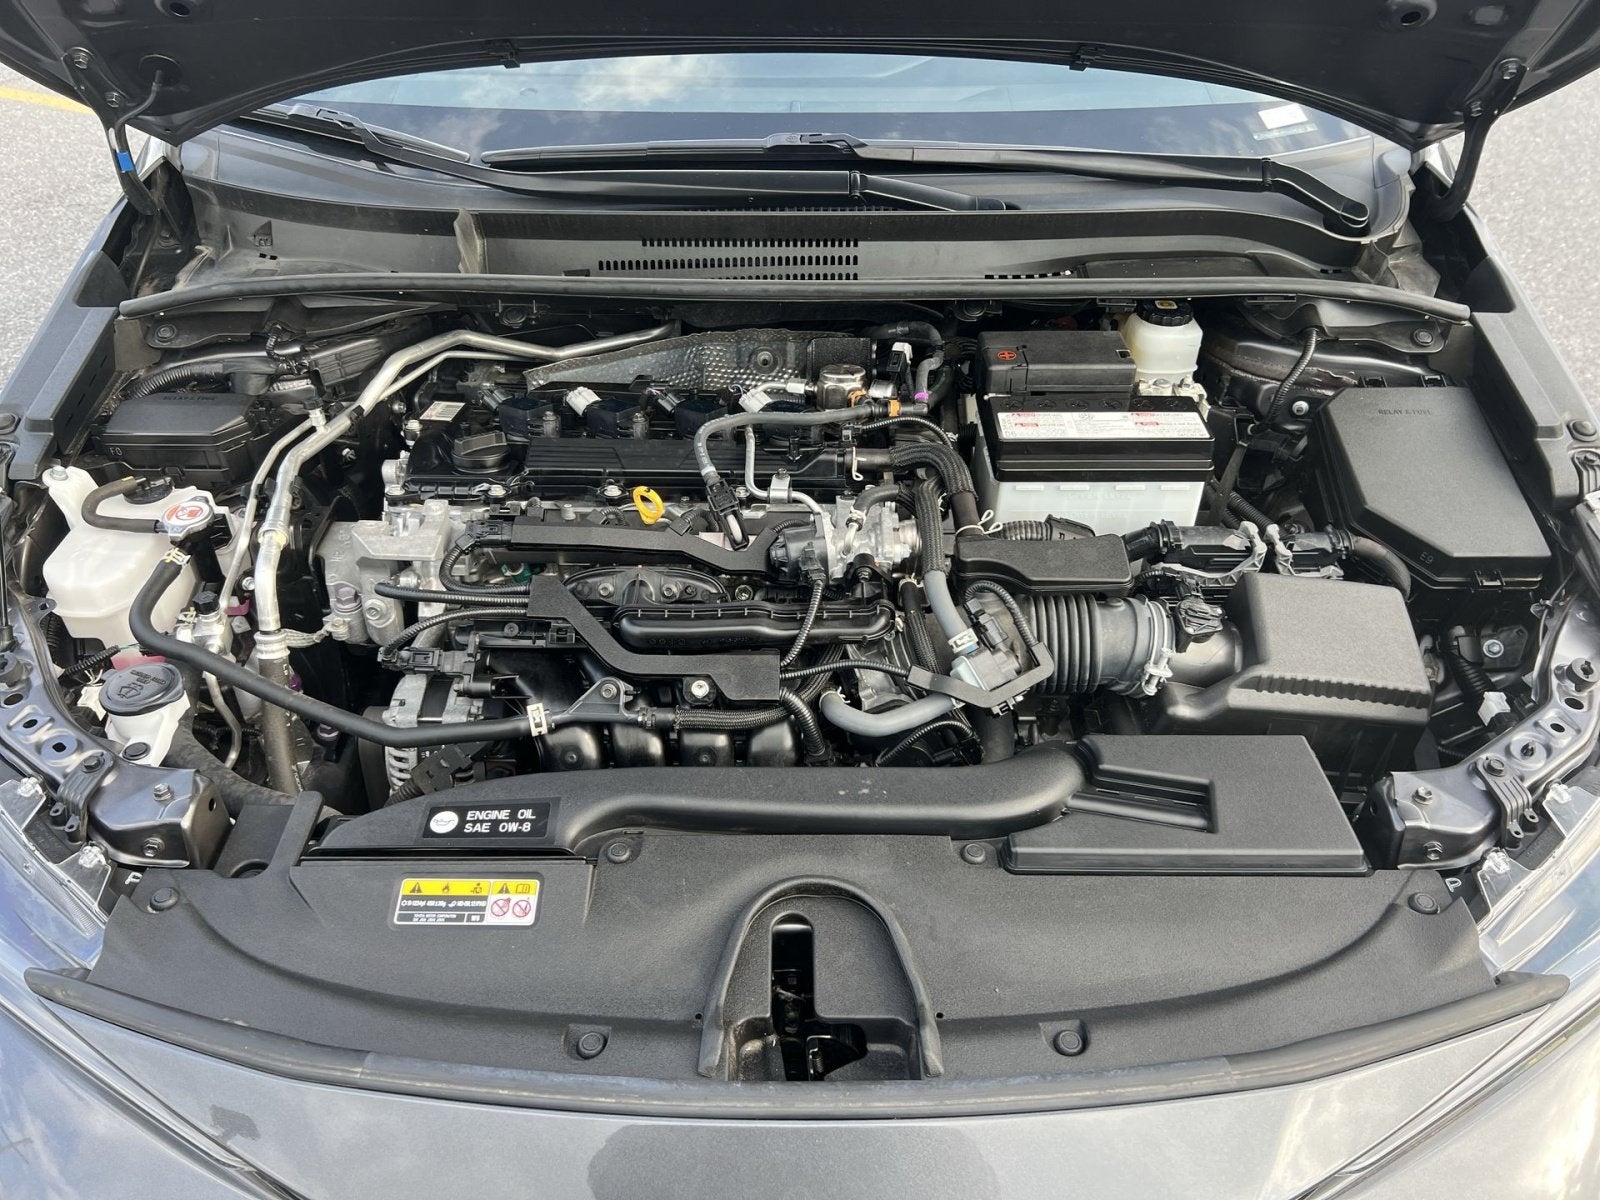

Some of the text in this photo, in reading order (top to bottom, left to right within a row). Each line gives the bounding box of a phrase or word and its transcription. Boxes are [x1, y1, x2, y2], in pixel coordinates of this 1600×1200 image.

[1419, 551, 1434, 565] E9
[466, 809, 536, 821] ENGINE OIL
[463, 822, 531, 833] SAE 0W-8
